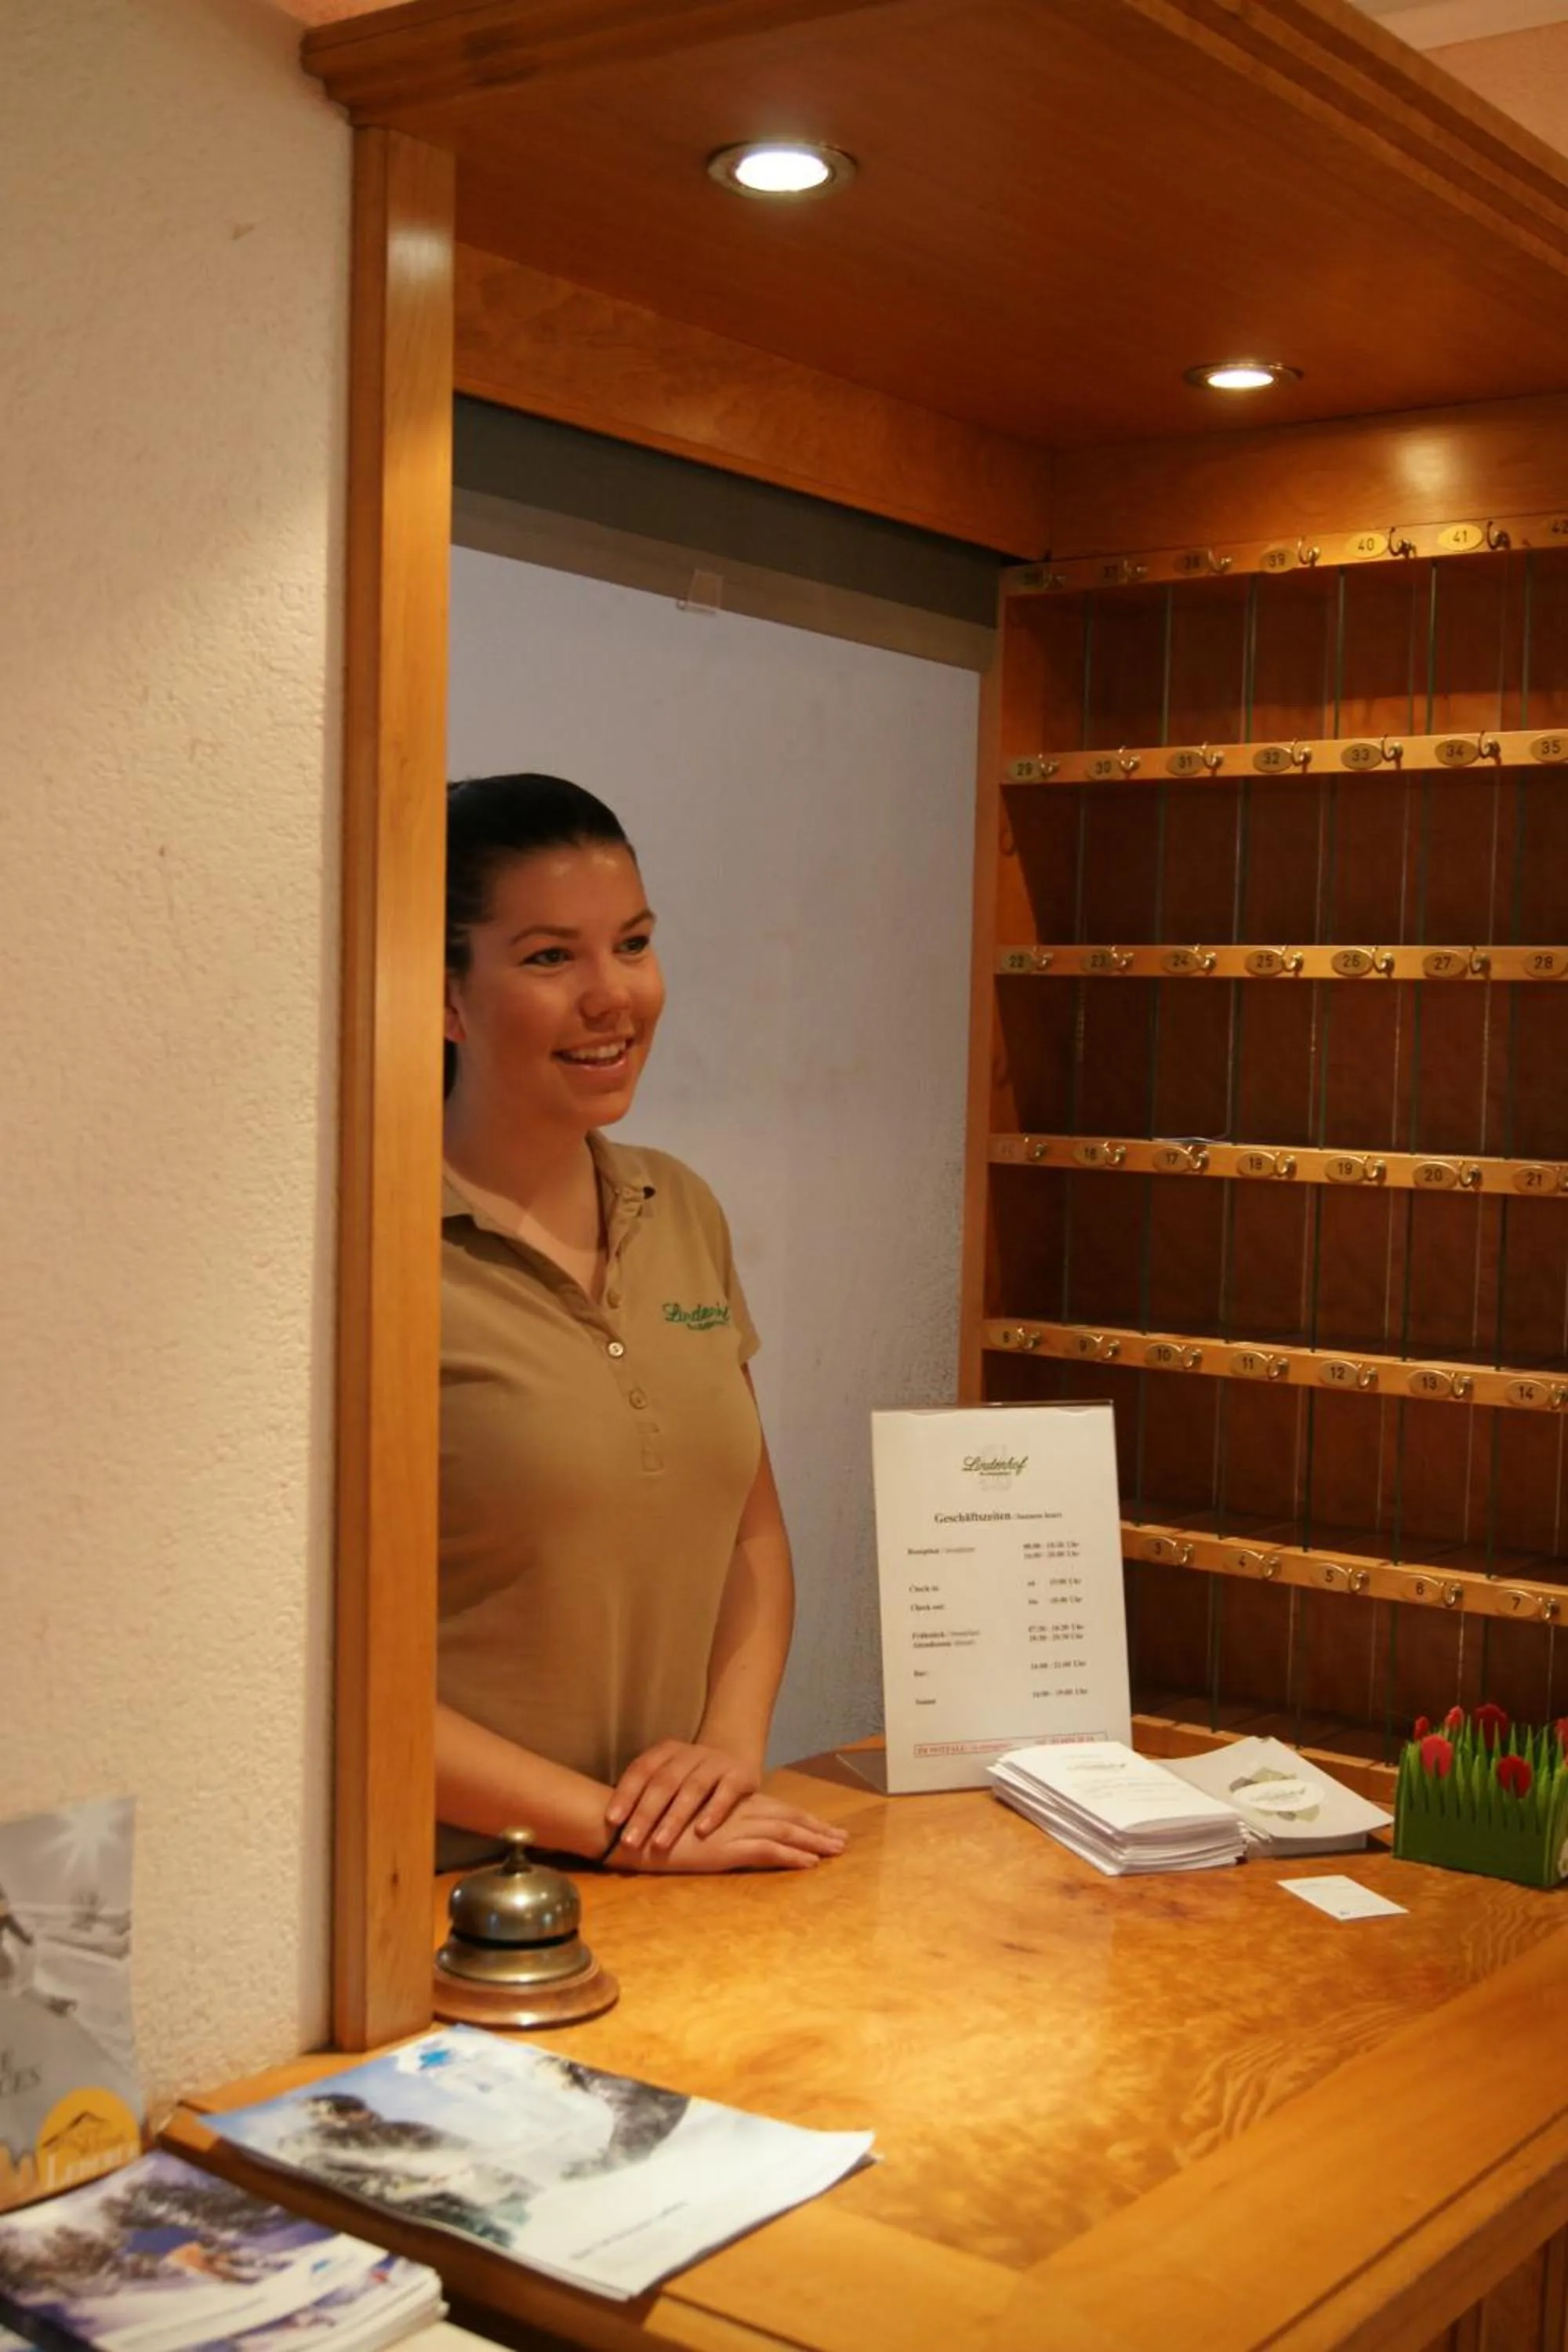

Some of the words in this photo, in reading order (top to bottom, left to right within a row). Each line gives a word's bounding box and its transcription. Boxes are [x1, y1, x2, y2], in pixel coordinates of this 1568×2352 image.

[1452, 529, 1468, 543] 41
[1356, 538, 1375, 551] 40
[1269, 551, 1286, 568] 39
[1445, 744, 1465, 758] 34
[1541, 740, 1562, 755] 35
[1178, 752, 1193, 768] 31
[1263, 752, 1280, 765] 32
[1351, 748, 1370, 762] 33
[1017, 761, 1033, 776] 29
[1095, 760, 1112, 775] 30
[1171, 953, 1189, 967] 24
[1256, 954, 1274, 968] 25
[1341, 954, 1361, 967] 26
[1433, 956, 1452, 971] 27
[1534, 955, 1554, 970] 28
[1166, 1152, 1179, 1165] 17
[1248, 1156, 1263, 1171] 18
[1338, 1161, 1353, 1175] 19
[1424, 1167, 1443, 1182] 20
[1526, 1171, 1542, 1186] 21
[1156, 1348, 1171, 1362] 10
[1242, 1356, 1254, 1370] 11
[1330, 1367, 1344, 1380] 12
[1421, 1376, 1437, 1390] 13
[1519, 1385, 1534, 1399] 14
[1237, 1555, 1247, 1569] 4
[1324, 1570, 1334, 1584] 5
[1415, 1581, 1425, 1595] 6
[1511, 1596, 1522, 1610] 7
